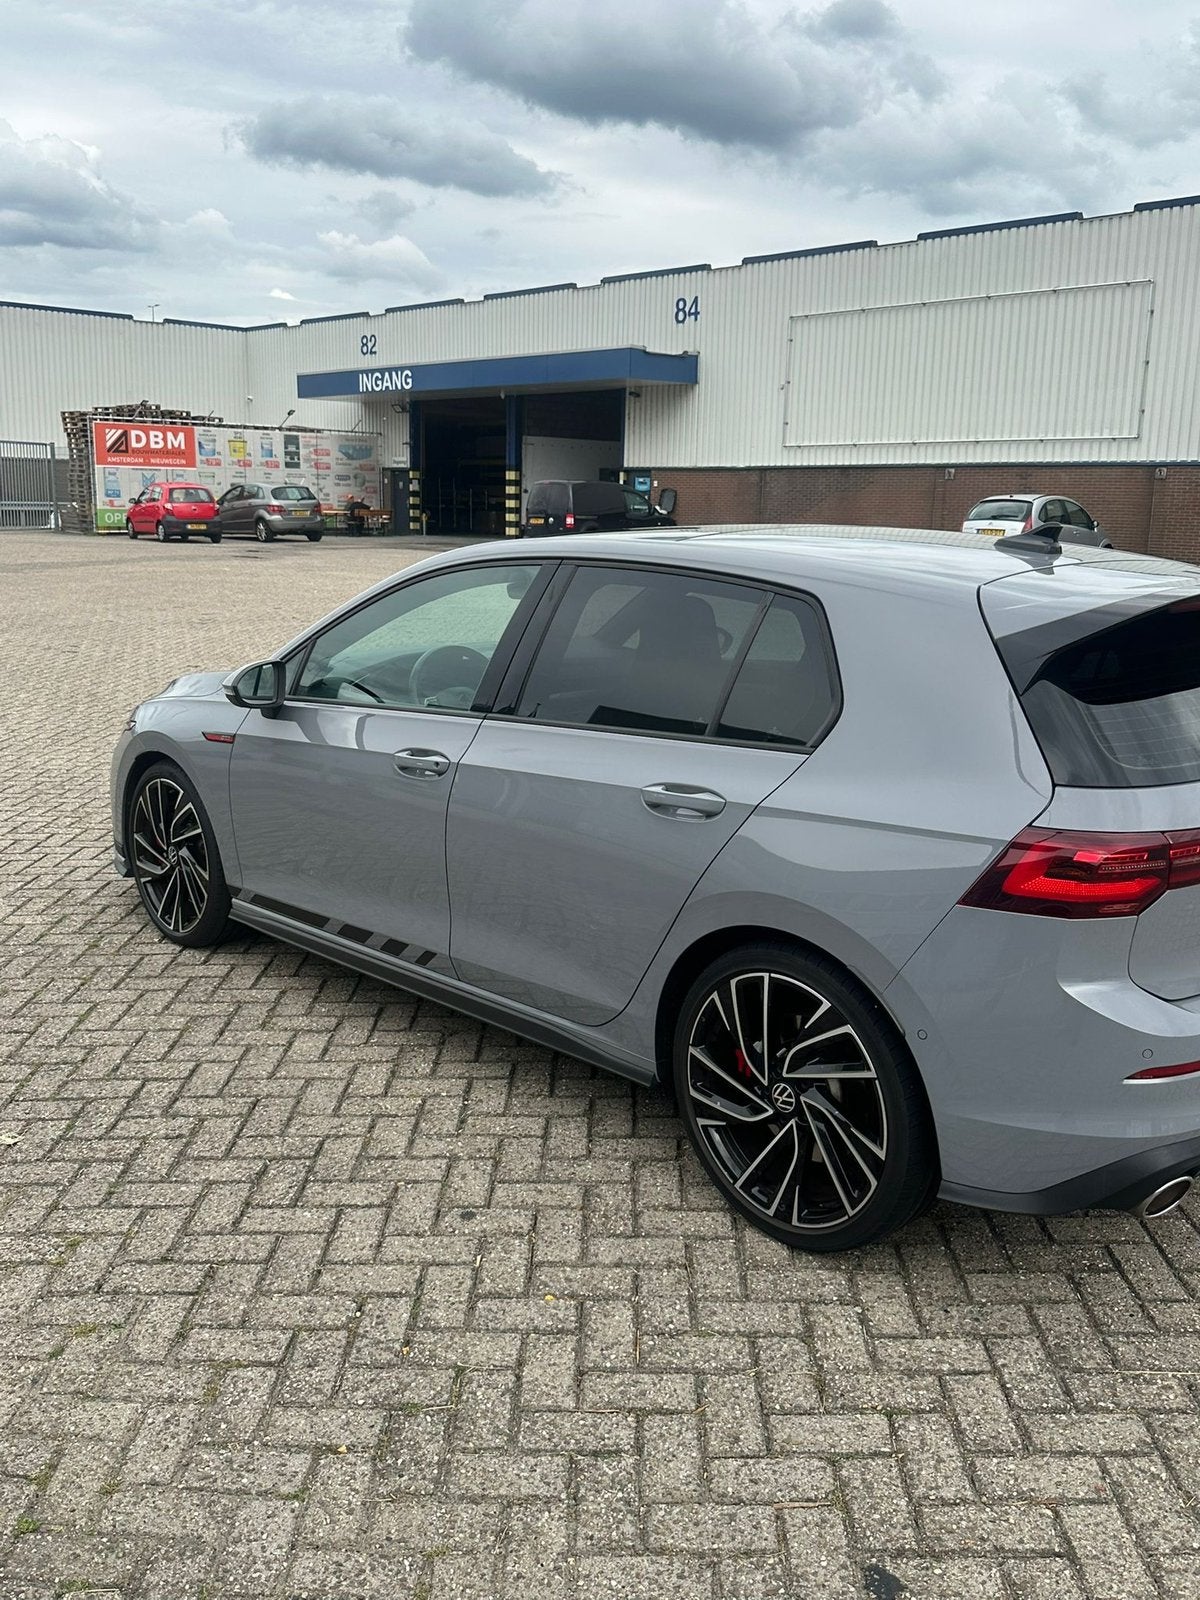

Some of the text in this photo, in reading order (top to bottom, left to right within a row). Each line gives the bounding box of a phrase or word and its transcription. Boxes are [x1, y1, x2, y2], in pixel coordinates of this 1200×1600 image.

[675, 295, 700, 325] 84
[360, 334, 377, 356] 82
[358, 370, 413, 392] INGANG
[130, 429, 186, 450] DBM
[107, 456, 144, 464] AMSTERDAM
[150, 457, 187, 465] NIEUWEGEIN
